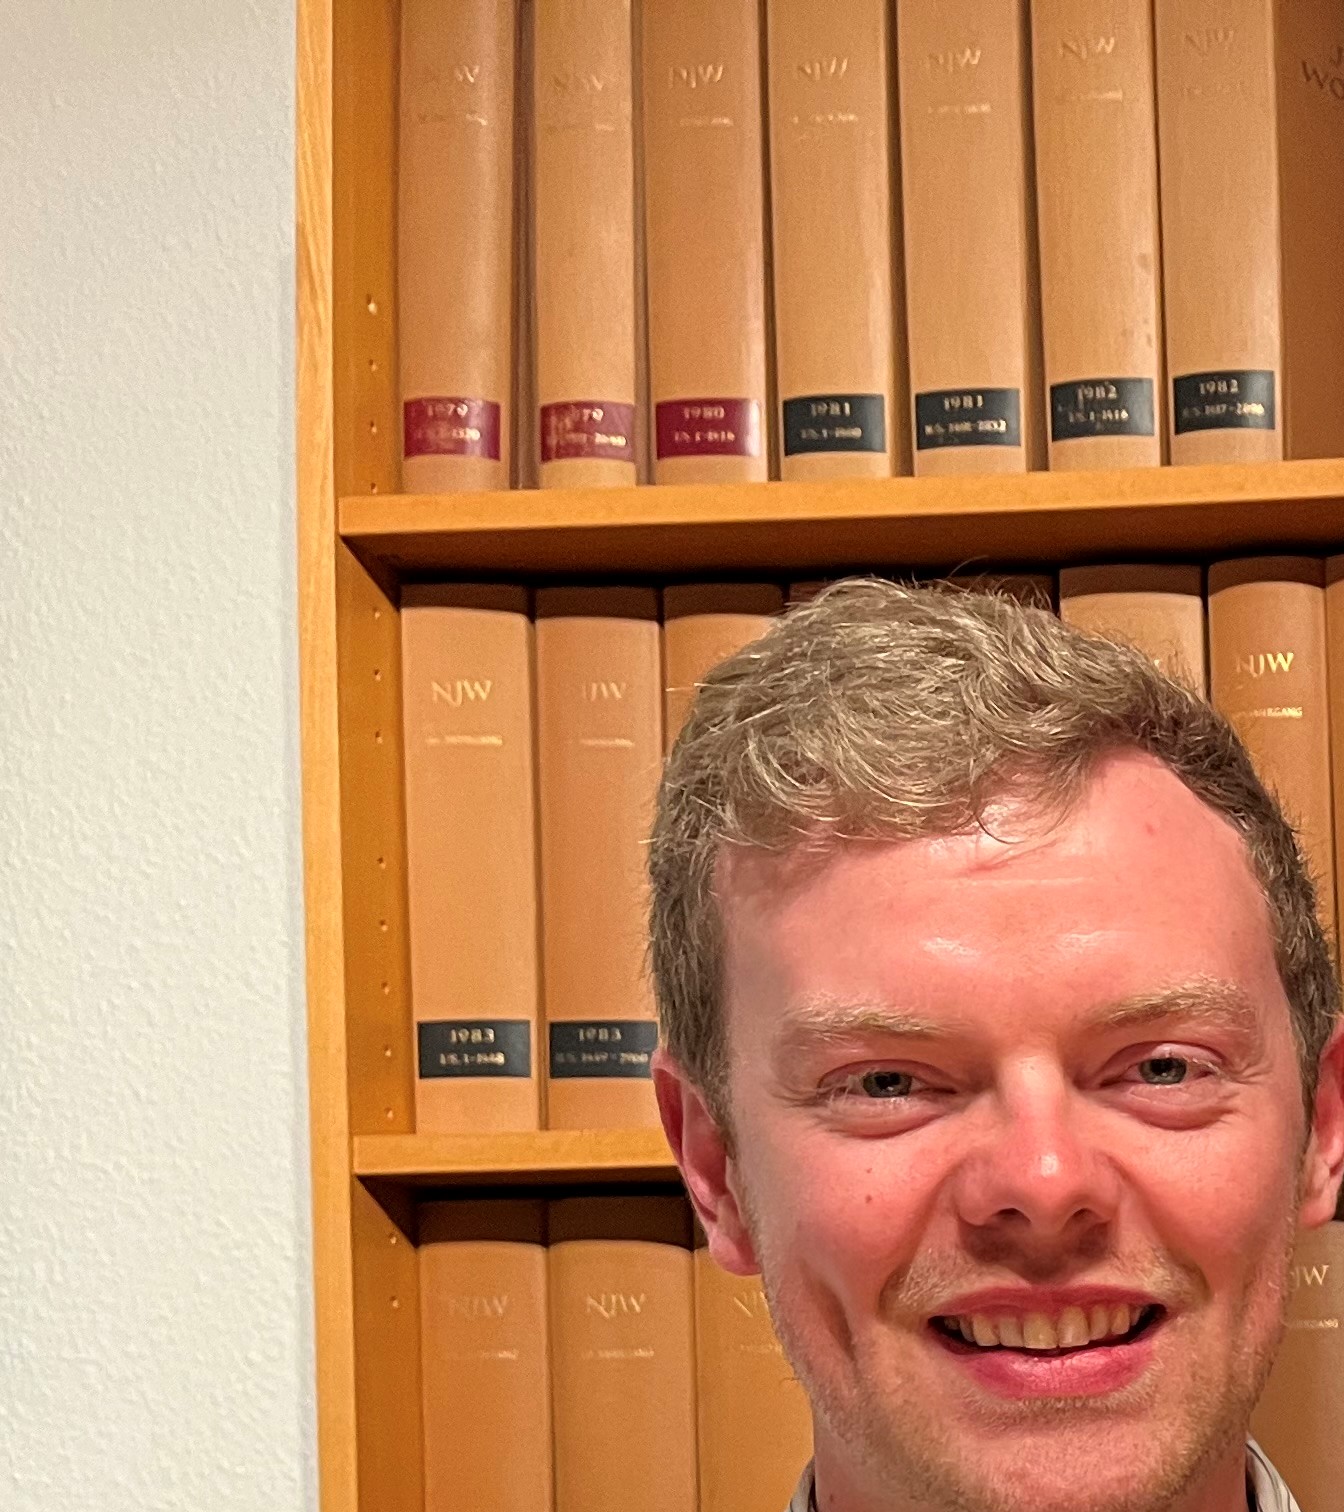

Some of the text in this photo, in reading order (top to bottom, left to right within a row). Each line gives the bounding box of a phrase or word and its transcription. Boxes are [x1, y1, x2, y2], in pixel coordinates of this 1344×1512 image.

[1235, 652, 1295, 678] NJW
[431, 680, 493, 706] NJW
[450, 1028, 495, 1044] 1983
